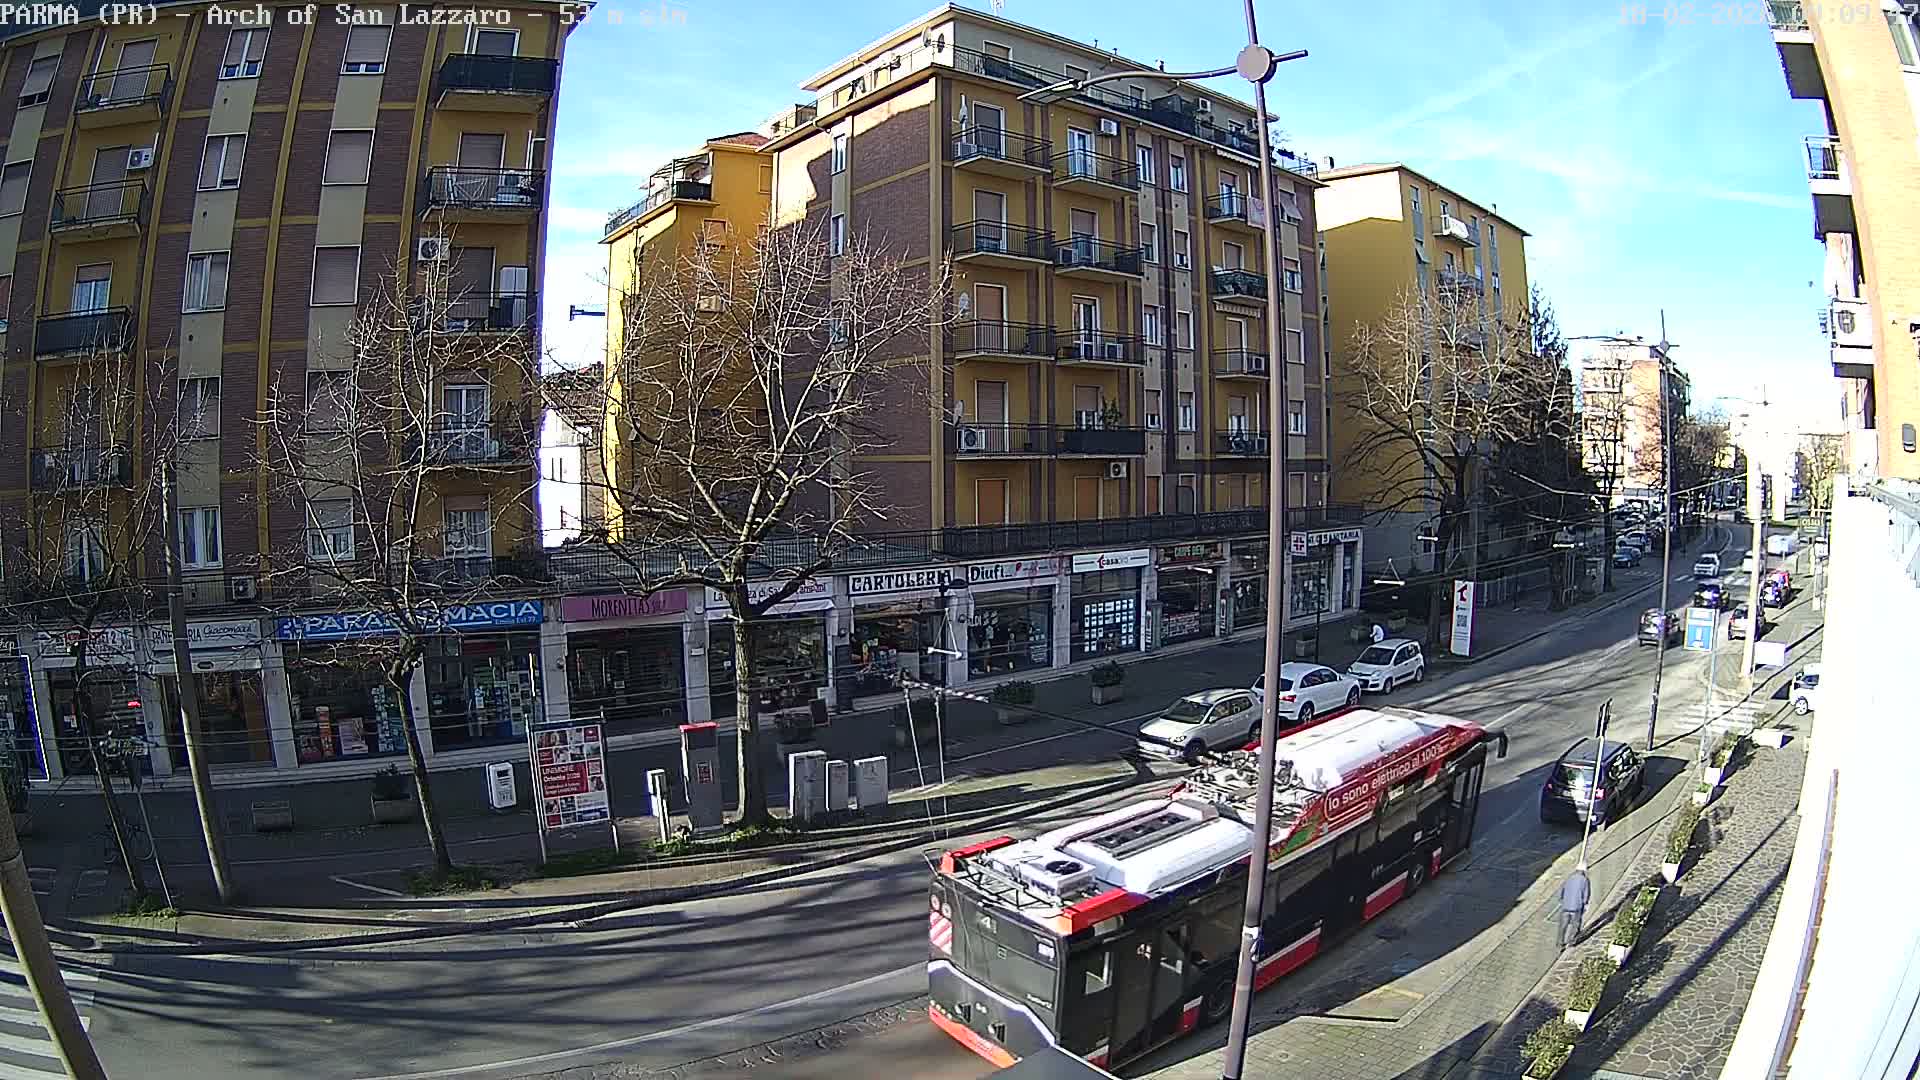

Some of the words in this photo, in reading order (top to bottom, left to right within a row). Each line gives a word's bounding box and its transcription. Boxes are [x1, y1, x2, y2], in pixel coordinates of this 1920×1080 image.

[851, 570, 950, 592] CARTOLERIA
[306, 602, 538, 632] PARAMACIA
[152, 626, 202, 645] PANERIA
[1342, 784, 1369, 803] sono
[1371, 760, 1411, 789] elettrico
